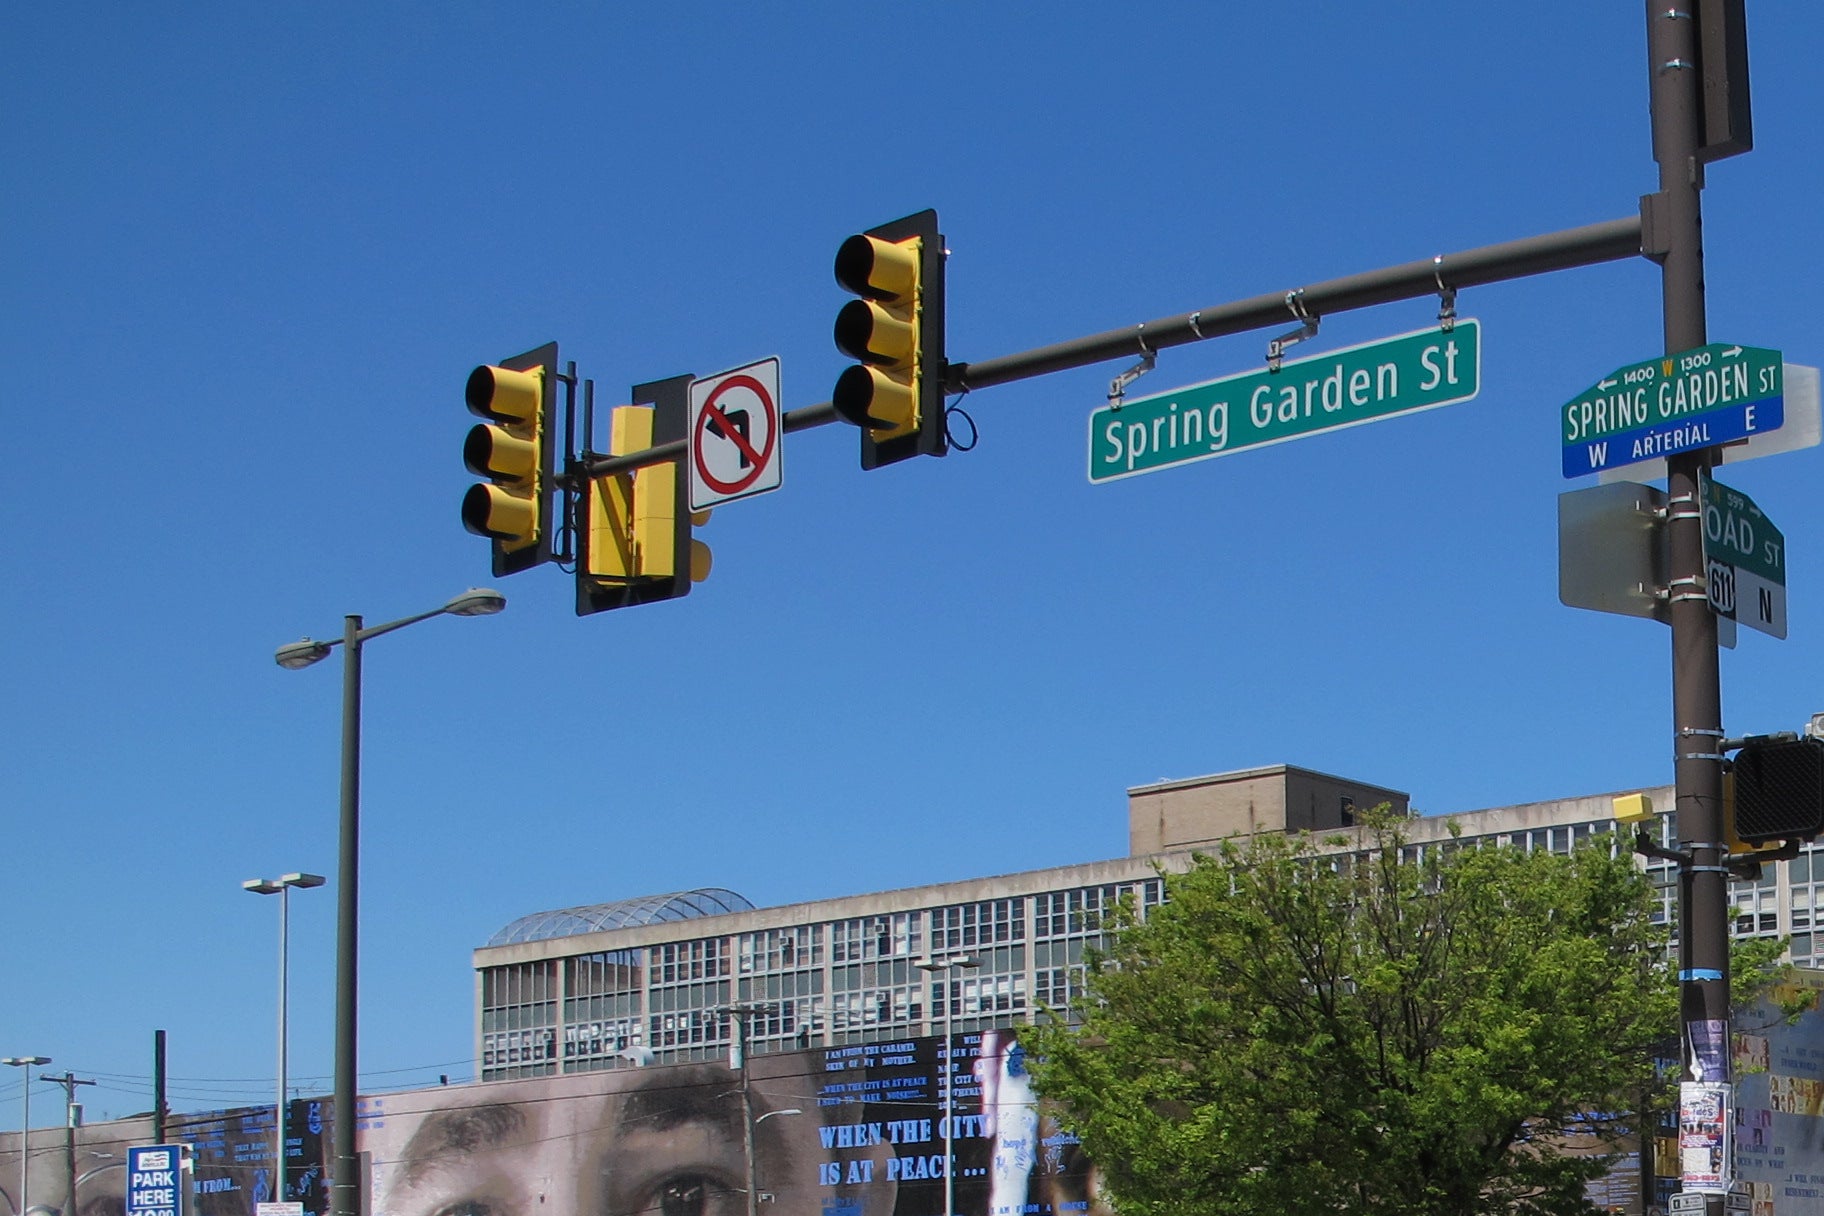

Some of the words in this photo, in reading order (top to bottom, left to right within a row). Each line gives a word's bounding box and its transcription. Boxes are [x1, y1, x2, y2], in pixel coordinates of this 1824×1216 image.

[1623, 366, 1655, 386] 1400
[1661, 358, 1674, 378] W
[1680, 351, 1711, 373] 1300
[1104, 402, 1229, 471] Spring
[1250, 363, 1399, 430] Garden
[1419, 339, 1460, 392] St
[1567, 386, 1649, 441] SPRING
[1658, 361, 1749, 418] GARDEN
[1758, 365, 1777, 393] ST
[1588, 441, 1608, 468] W
[1631, 421, 1711, 459] ARTERIAL
[1744, 405, 1756, 432] E
[1703, 504, 1755, 555] OAD
[1763, 541, 1780, 568] ST
[1711, 570, 1734, 610] 611
[1758, 586, 1773, 624] N
[881, 1043, 916, 1054] CARAMEL
[819, 1122, 883, 1149] WHEN
[887, 1118, 931, 1144] THE
[939, 1115, 990, 1140] CITY
[133, 1170, 175, 1188] PARK
[819, 1162, 841, 1185] IS
[846, 1160, 874, 1185] AT
[133, 1188, 175, 1206] HERE
